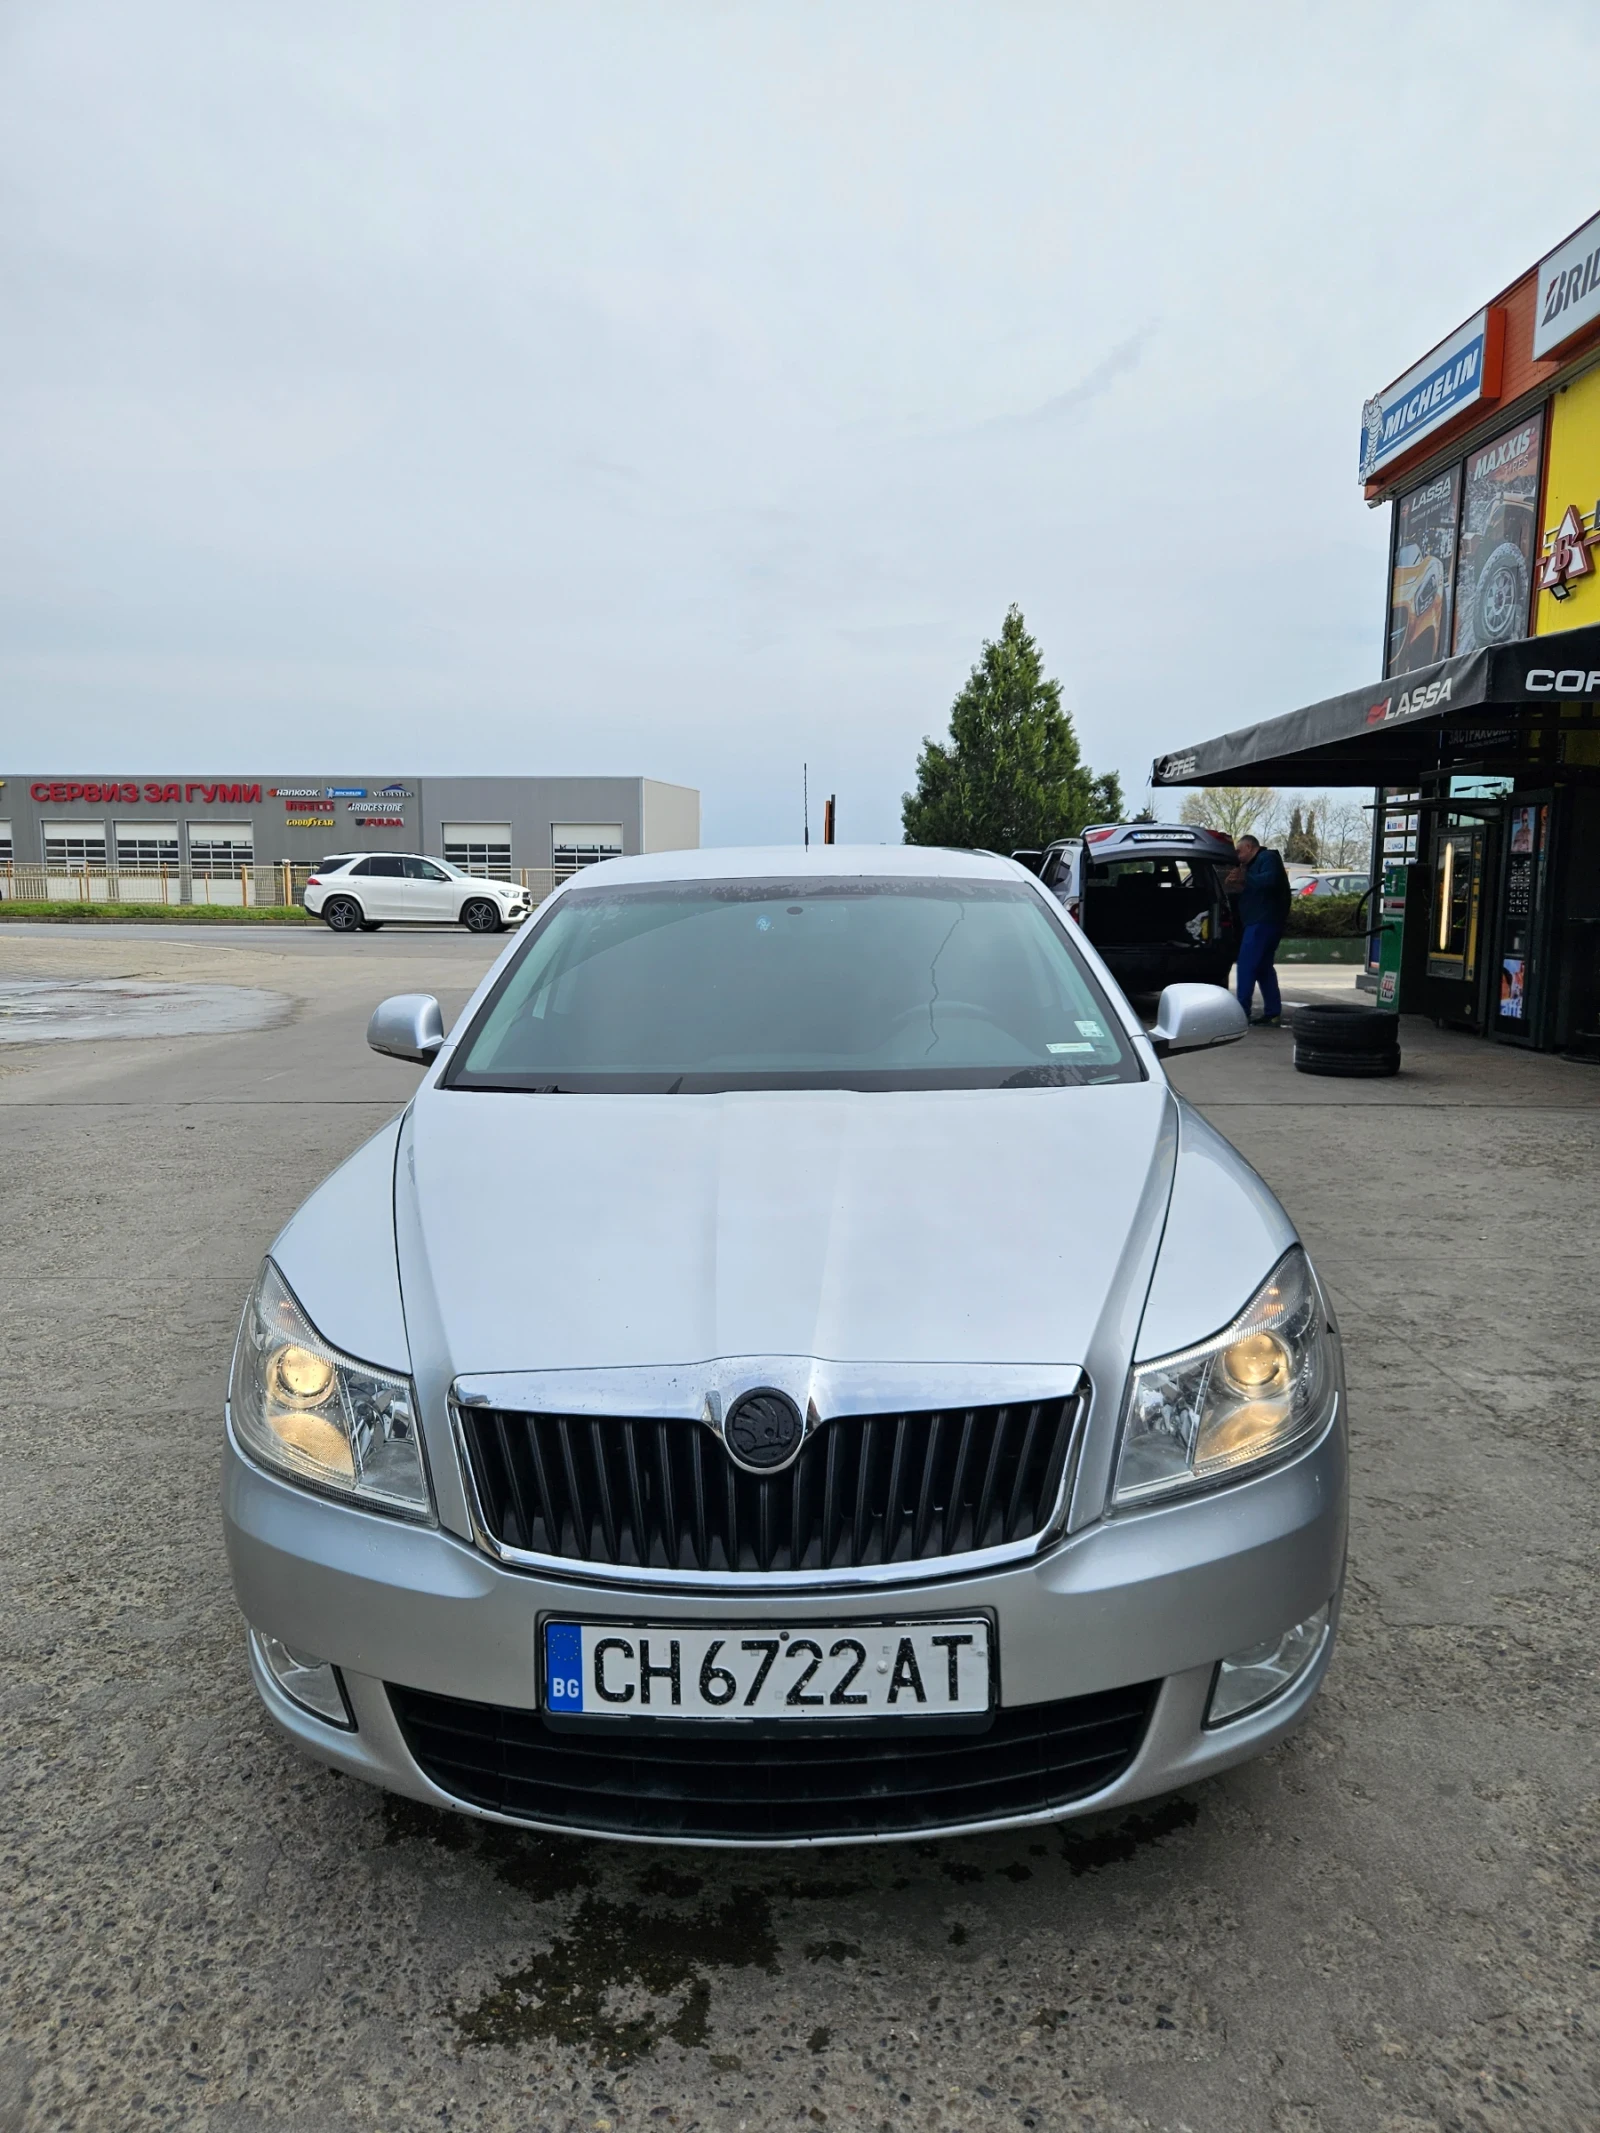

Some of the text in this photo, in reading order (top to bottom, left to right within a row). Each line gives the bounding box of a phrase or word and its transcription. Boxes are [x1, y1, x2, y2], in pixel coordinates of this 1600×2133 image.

[1383, 347, 1479, 443] MICHELIN
[1474, 427, 1531, 481] MAXXIS
[1503, 454, 1529, 477] TIRES
[1411, 476, 1452, 512] LASSA
[1384, 677, 1452, 721] LASSA
[30, 782, 262, 803] СЕРВИЗ ЗА ГУМИ
[347, 802, 404, 812] BRIDGESTONE
[286, 817, 335, 828] GOODYEAR
[364, 817, 405, 828] FULDA
[700, 1637, 868, 1706] 6722
[552, 1678, 580, 1698] BG
